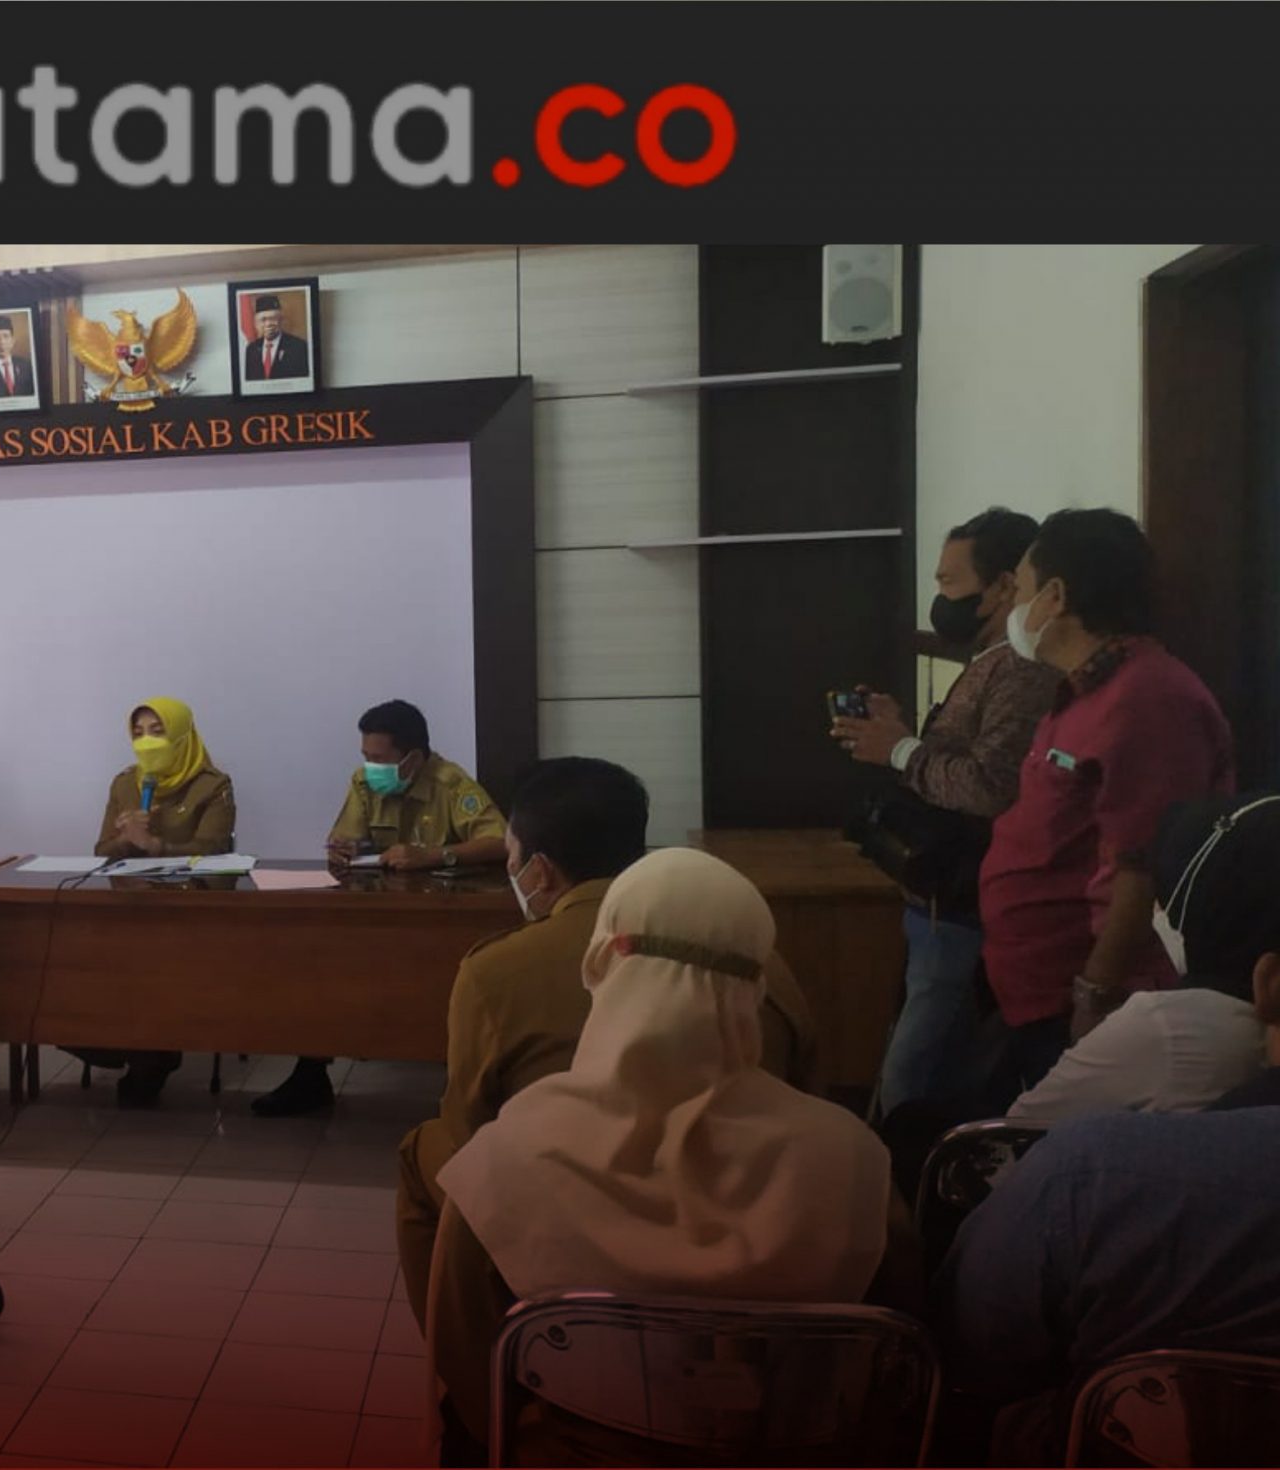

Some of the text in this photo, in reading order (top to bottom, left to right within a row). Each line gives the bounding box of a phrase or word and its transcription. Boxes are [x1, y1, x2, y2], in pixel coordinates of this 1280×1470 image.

[30, 423, 146, 456] SOSIAL
[151, 418, 232, 451] KAB
[241, 409, 375, 446] GRESIK
